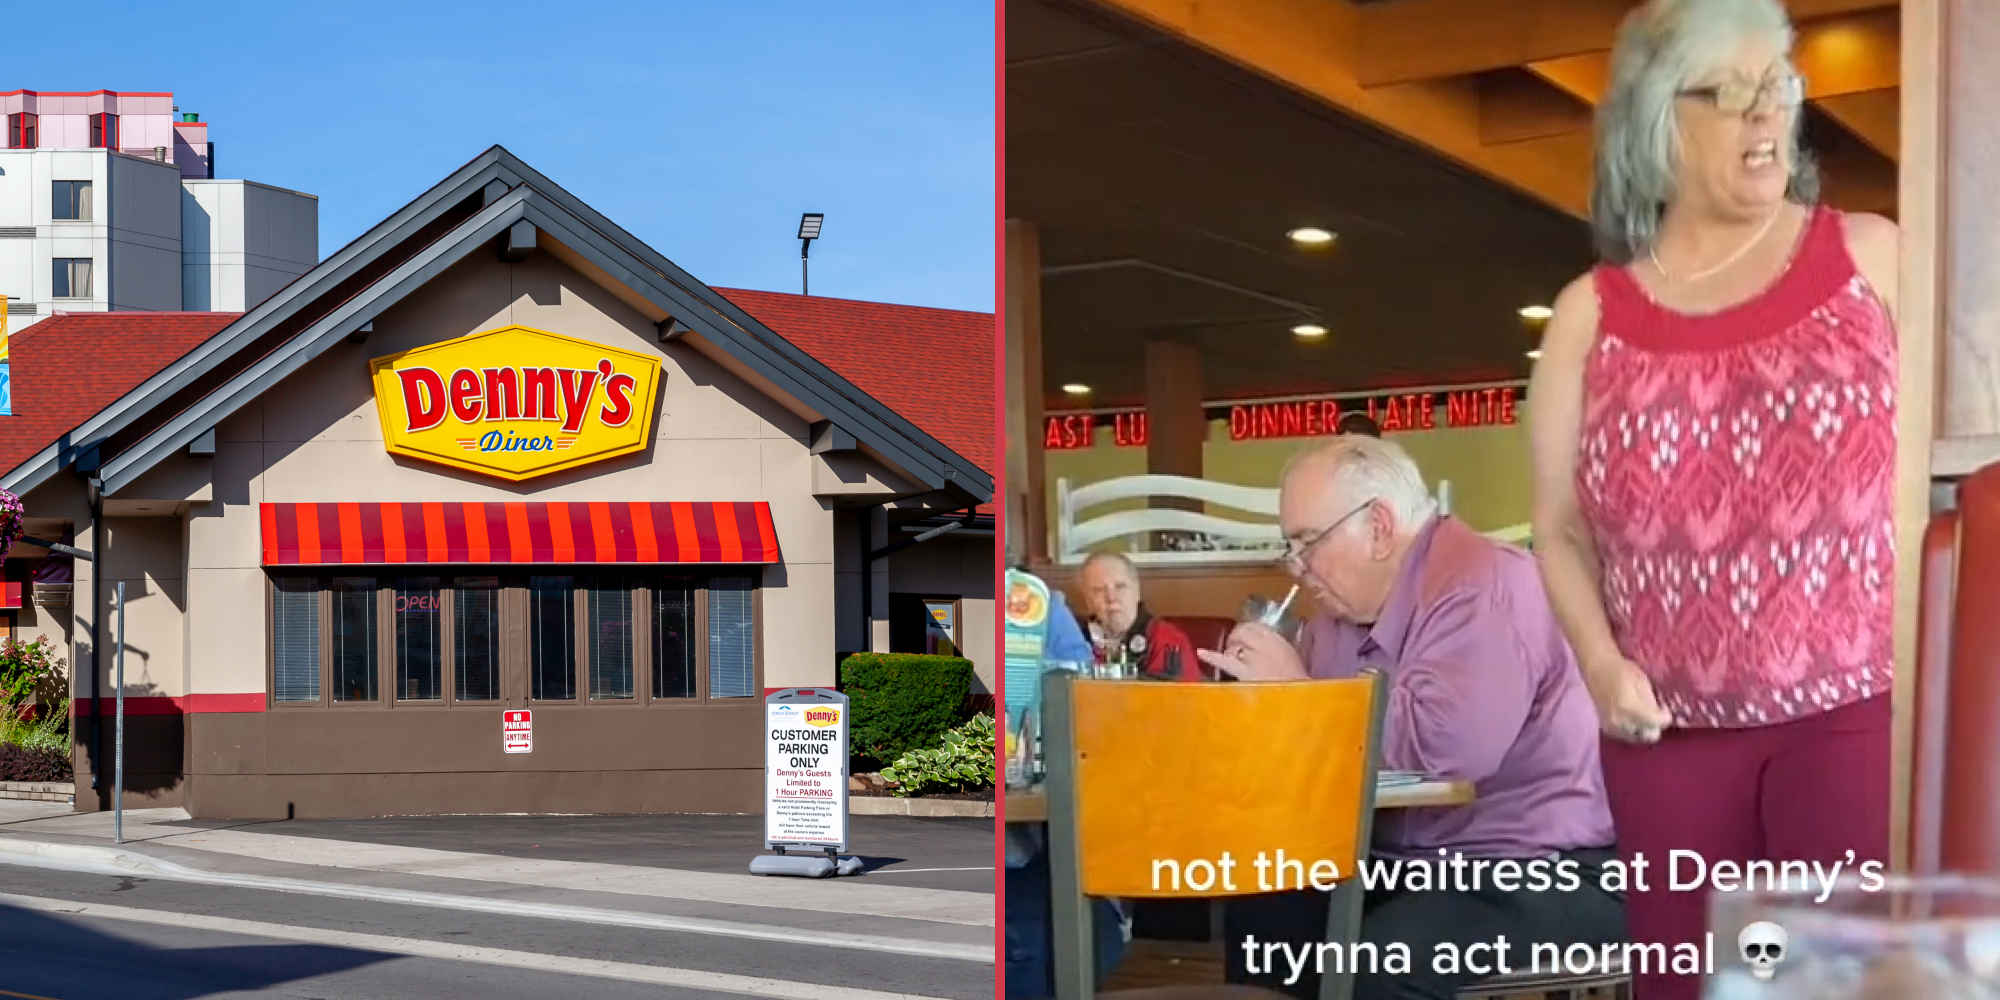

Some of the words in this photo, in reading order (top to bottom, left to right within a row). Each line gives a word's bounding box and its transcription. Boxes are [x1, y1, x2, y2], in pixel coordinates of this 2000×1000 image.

[394, 358, 636, 433] Denny's
[1230, 399, 1339, 440] DINNER
[1447, 387, 1515, 427] NITE
[479, 430, 554, 452] Diner
[396, 596, 440, 611] OPEN
[513, 713, 522, 721] NO
[806, 710, 838, 723] Denny's
[505, 721, 530, 730] PARKING
[506, 733, 530, 741] ANYTIME
[771, 729, 837, 741] CUSTOMER
[778, 743, 829, 755] PARKING
[790, 757, 820, 768] ONLY
[776, 768, 804, 778] Denny's
[805, 769, 832, 777] Guests
[786, 779, 812, 787] Limited
[814, 779, 821, 787] to
[776, 788, 779, 796] 1
[780, 788, 798, 796] Hour
[799, 789, 833, 797] PARKING
